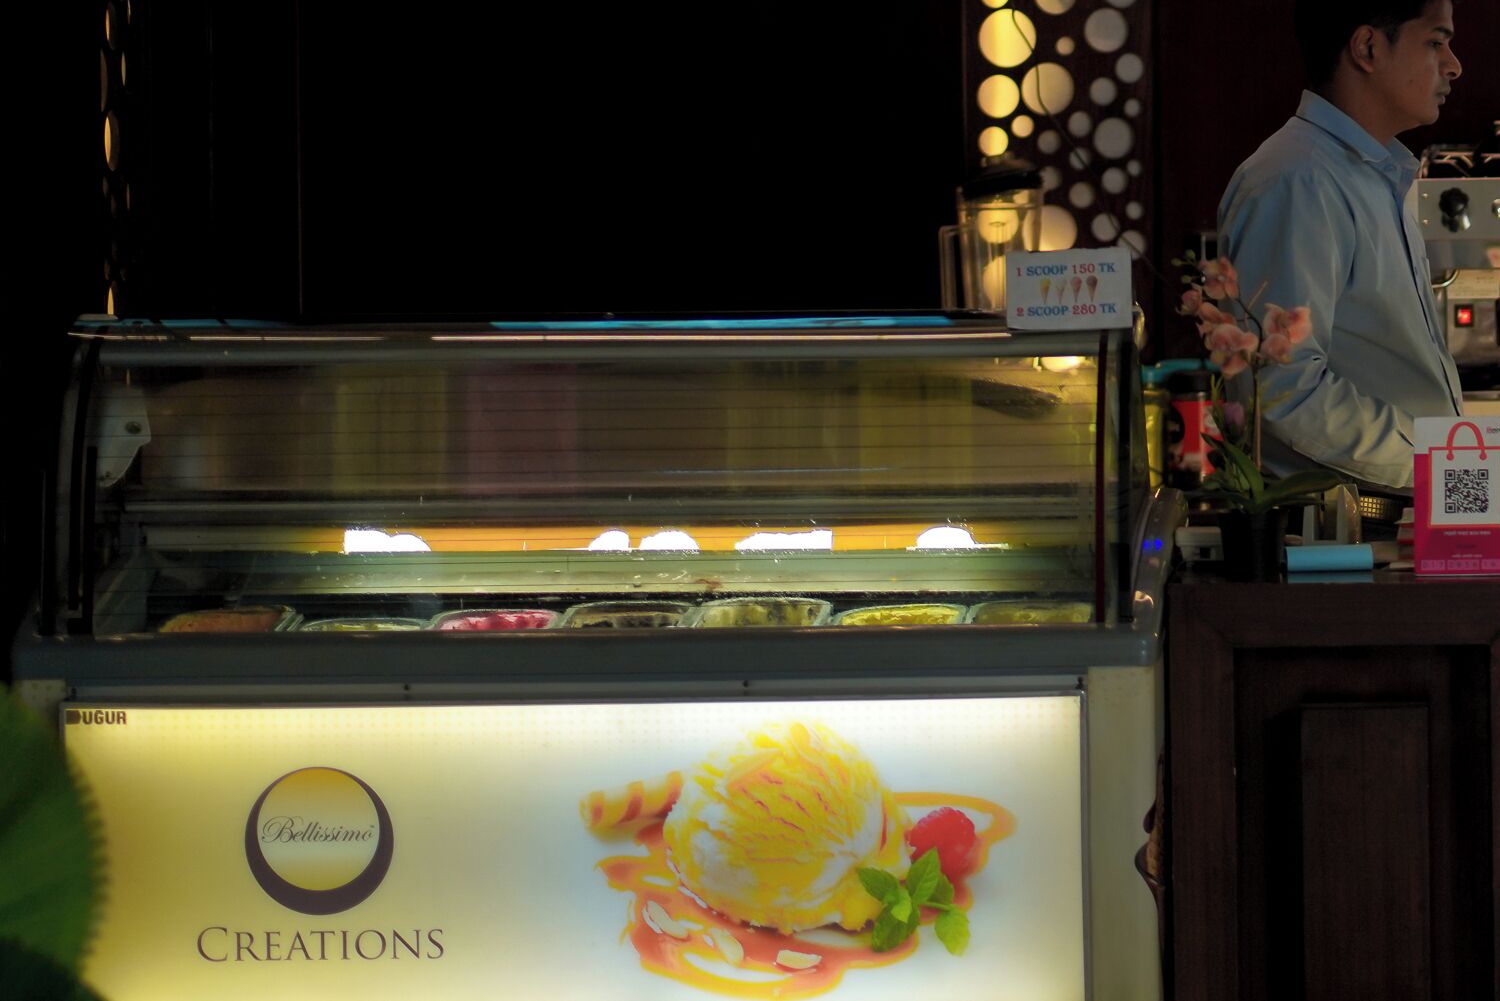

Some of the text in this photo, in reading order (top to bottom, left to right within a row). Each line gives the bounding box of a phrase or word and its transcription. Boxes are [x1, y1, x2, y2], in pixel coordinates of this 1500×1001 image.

[1016, 262, 1116, 277] 1 SCOOP 150 TK
[1016, 302, 1117, 317] 2 SCOOP 280 TK
